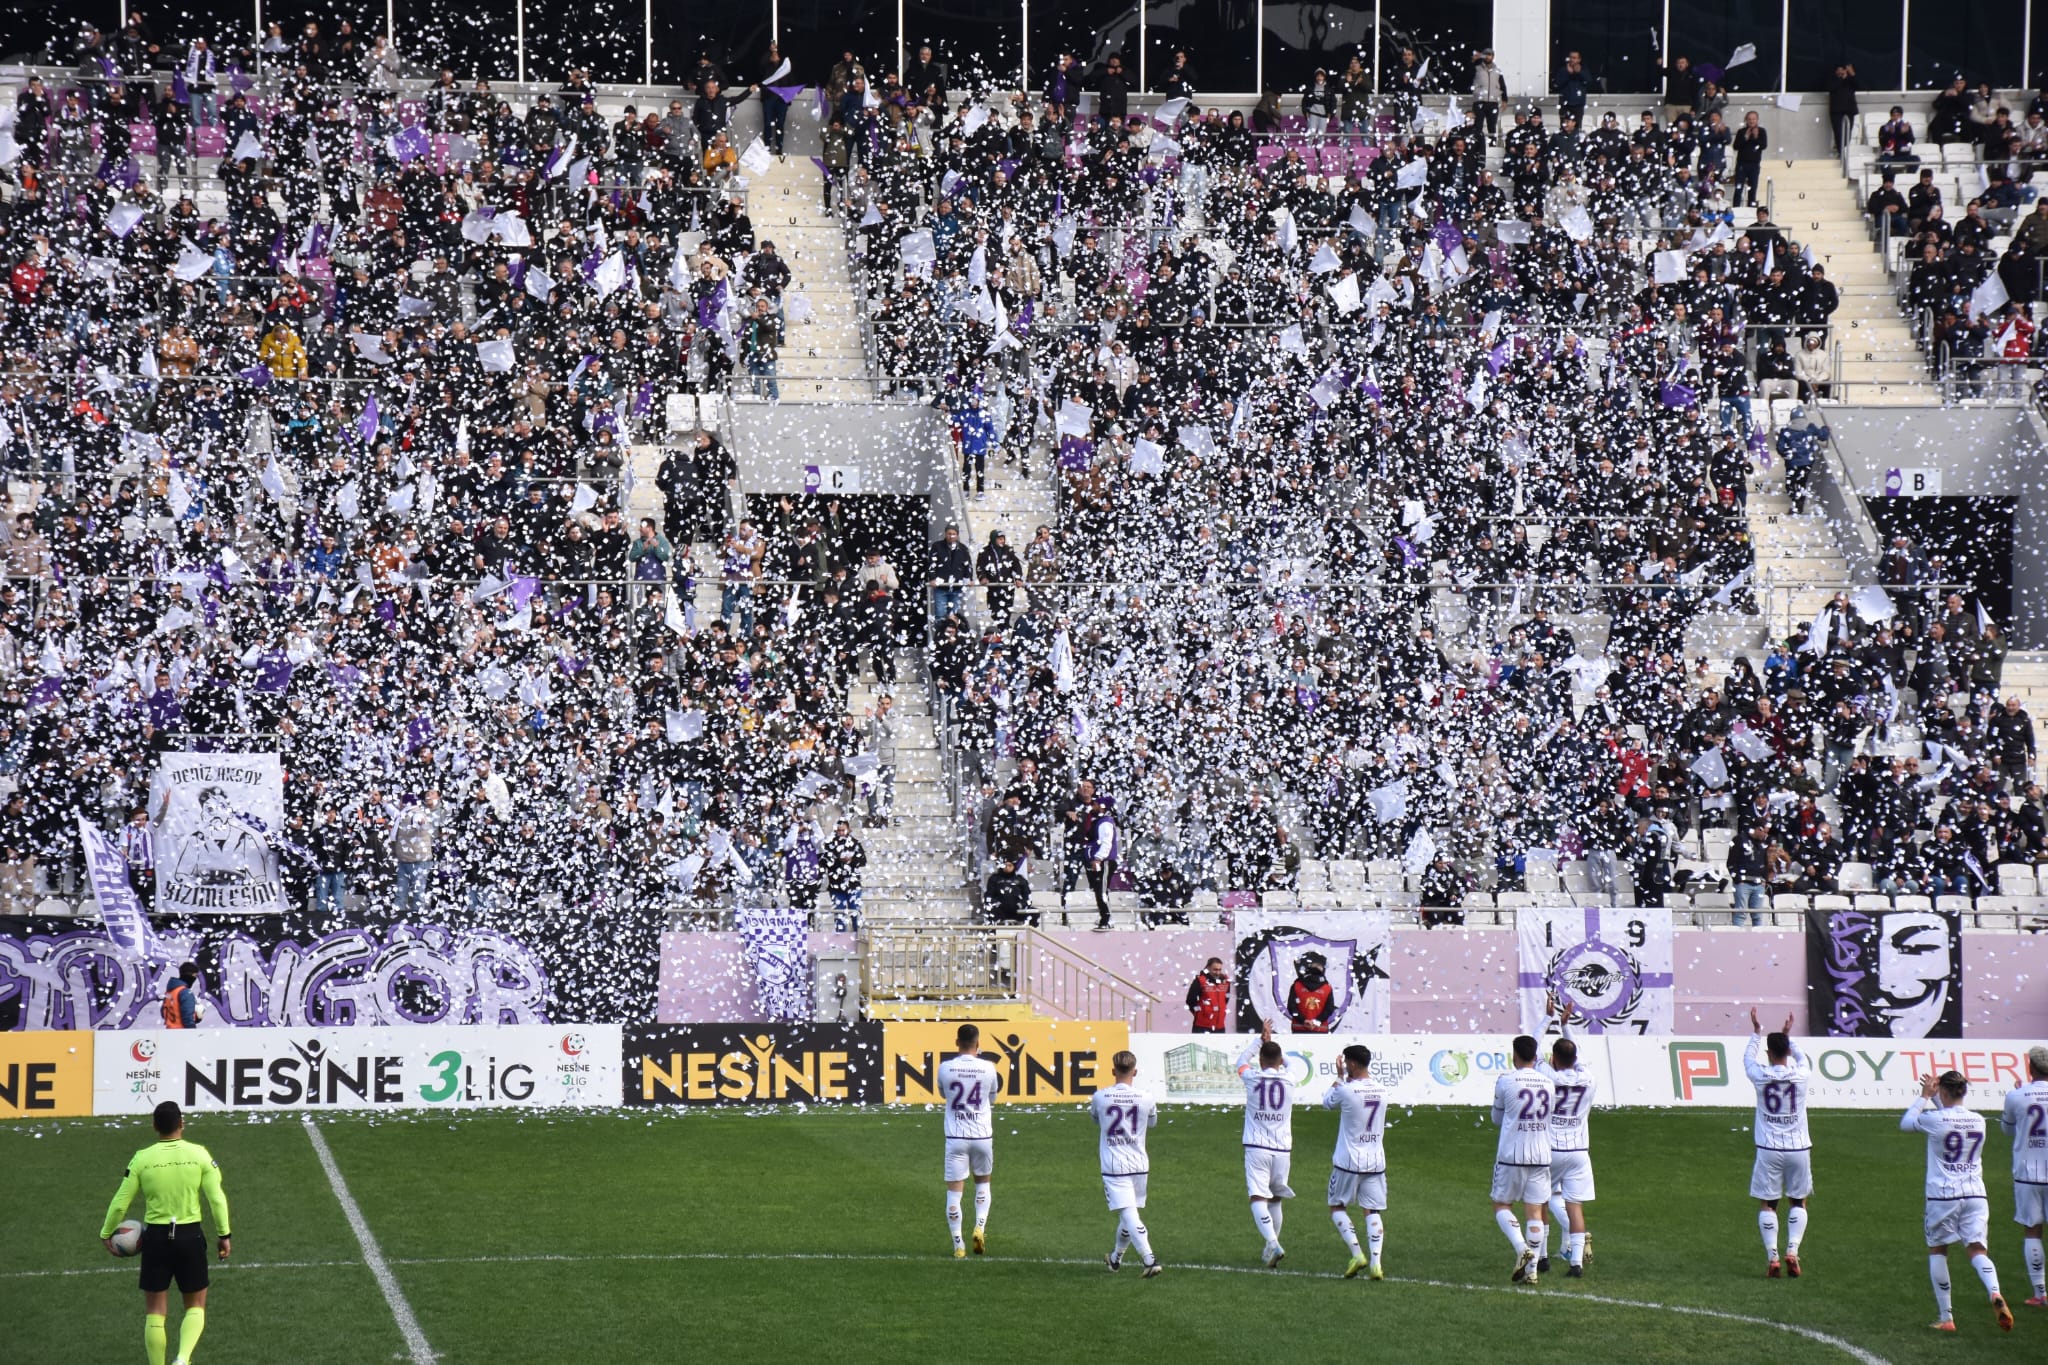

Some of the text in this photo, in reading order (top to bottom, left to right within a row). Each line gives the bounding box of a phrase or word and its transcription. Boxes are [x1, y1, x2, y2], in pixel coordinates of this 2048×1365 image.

[833, 471, 843, 489] C
[1914, 473, 1925, 491] B
[1545, 920, 1646, 947] 1 9
[949, 1081, 982, 1110] 24
[1254, 1077, 1285, 1111] 10
[1518, 1088, 1549, 1119] 23
[1554, 1086, 1587, 1116] 27
[1763, 1083, 1797, 1115] 61
[1105, 1104, 1139, 1137] 21
[1364, 1100, 1380, 1132] 7
[1943, 1131, 1983, 1164] 97
